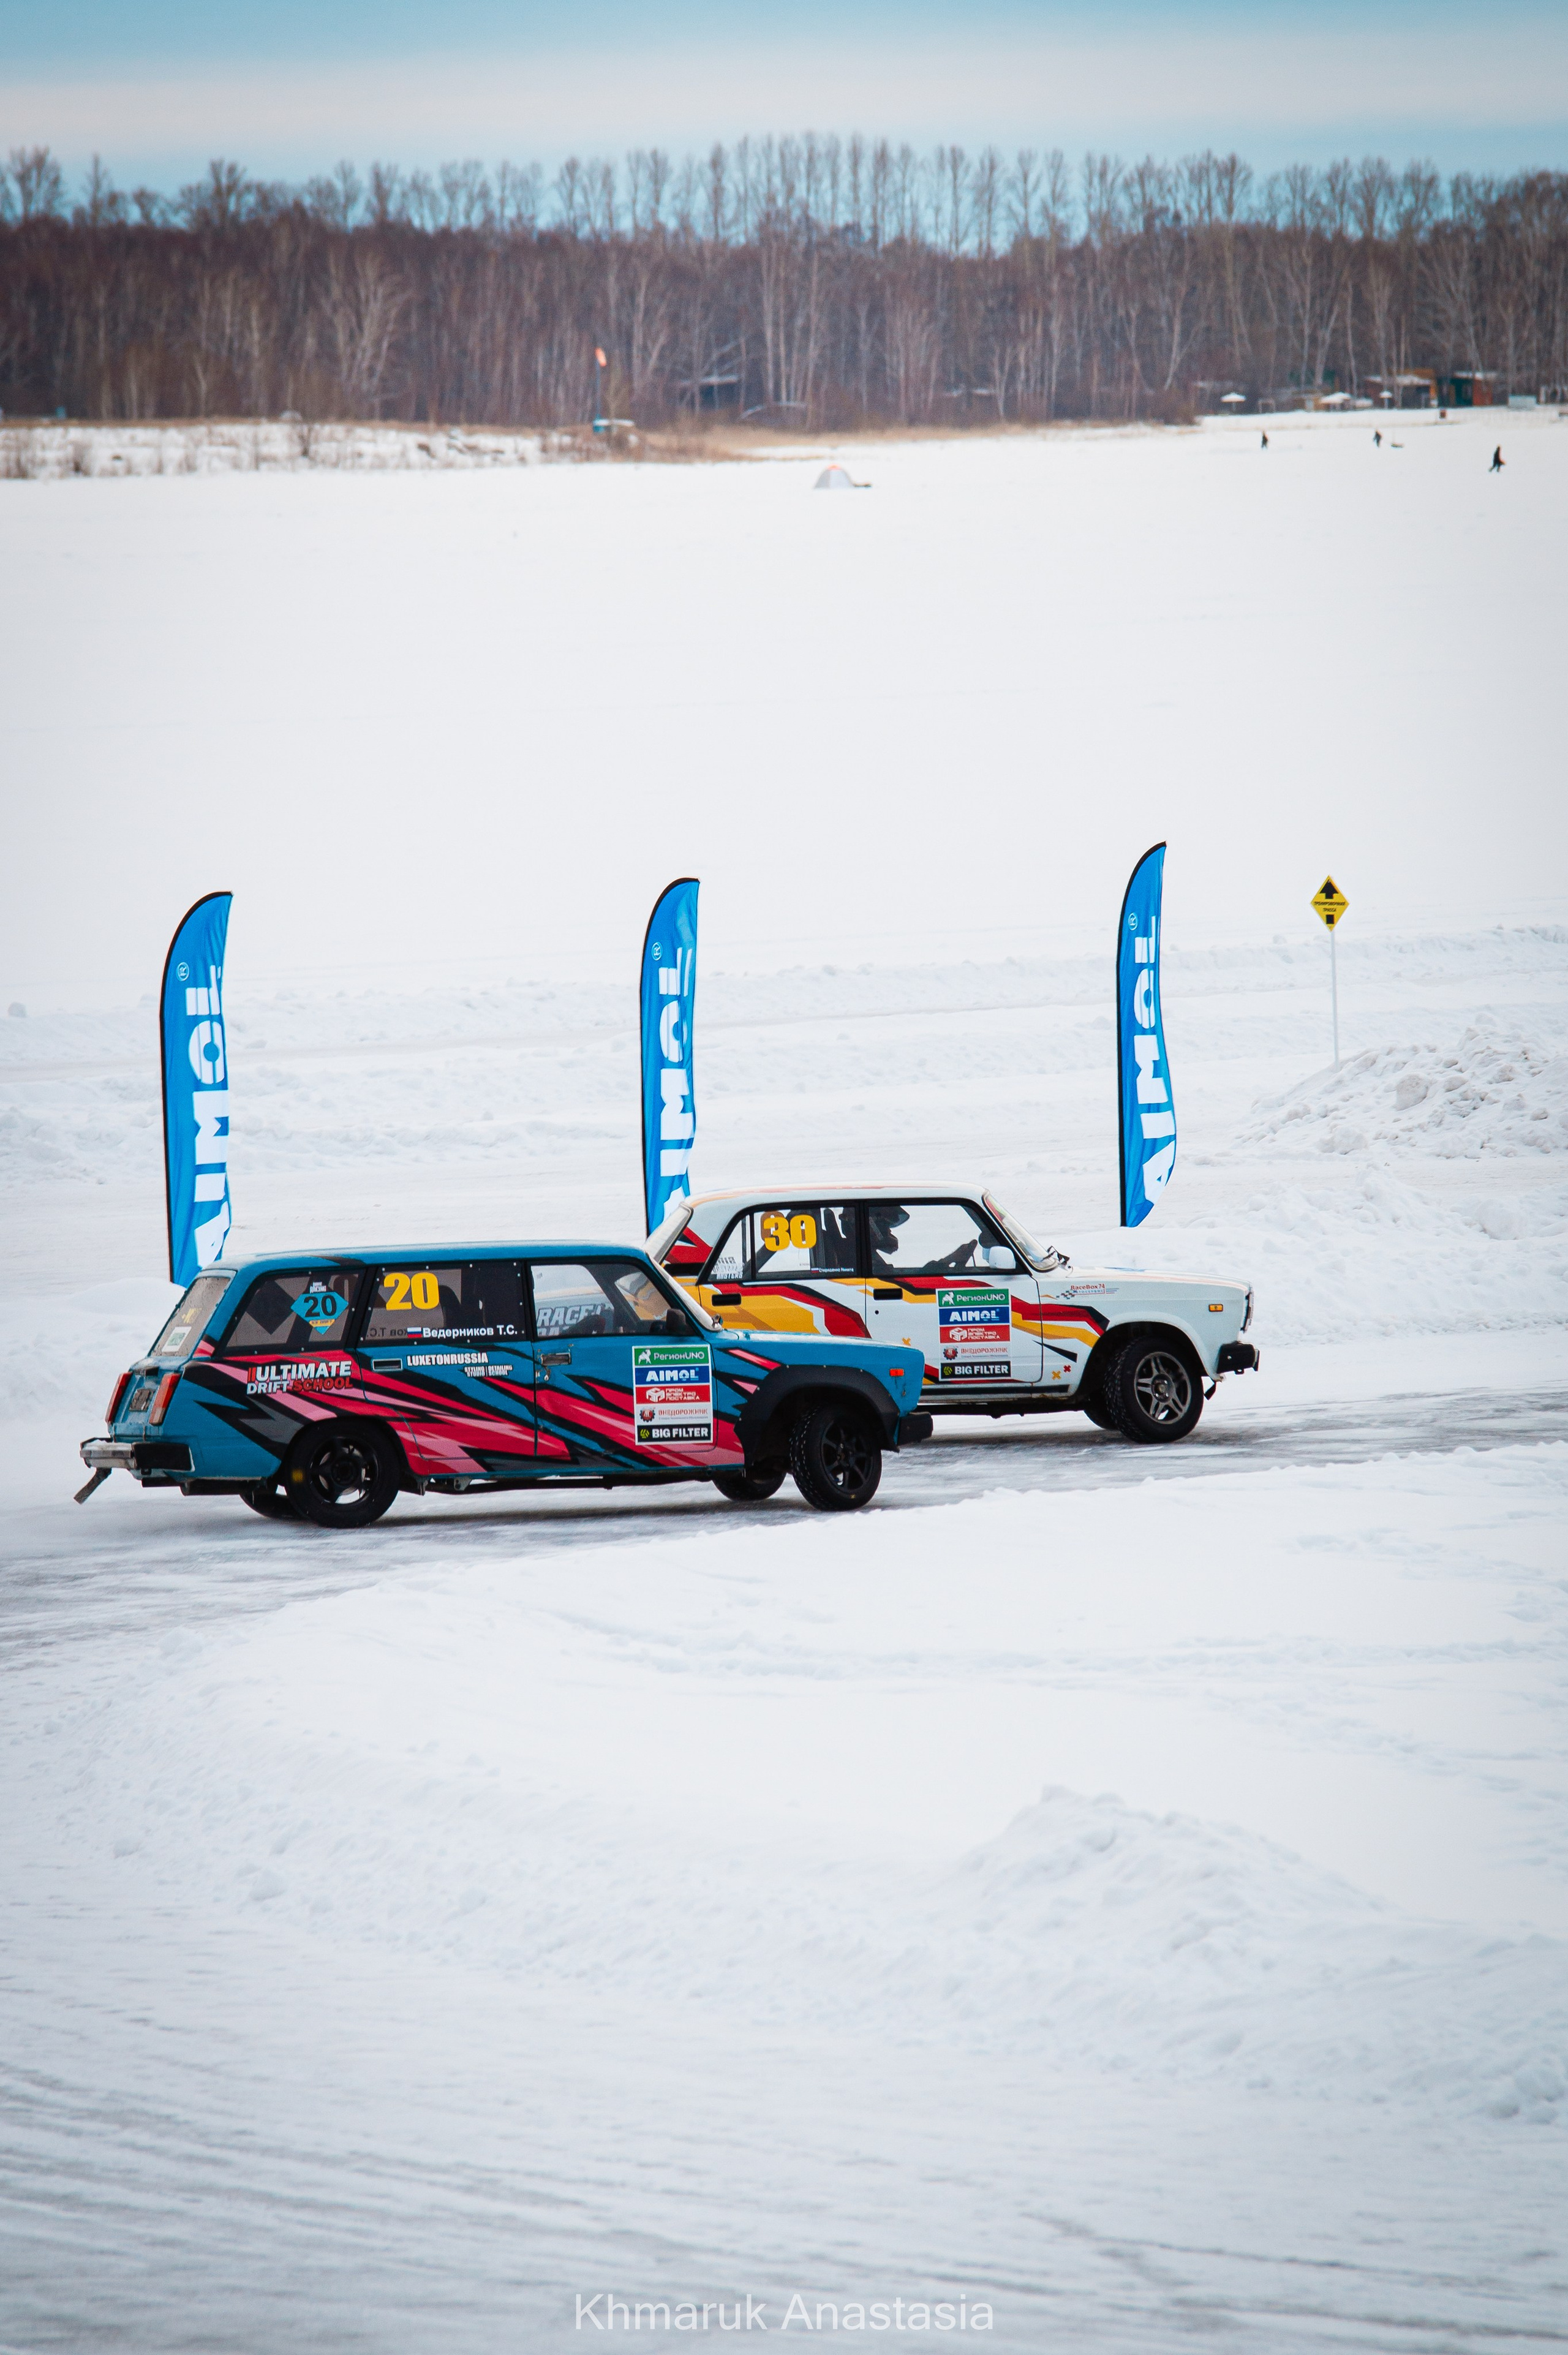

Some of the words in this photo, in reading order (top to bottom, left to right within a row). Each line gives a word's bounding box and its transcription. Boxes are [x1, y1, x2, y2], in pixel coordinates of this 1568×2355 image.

[1134, 916, 1176, 1205] AIMOL
[186, 965, 230, 1269] AIMOL
[763, 1215, 817, 1251] 30
[384, 1272, 440, 1310] 20
[303, 1295, 337, 1317] 20
[949, 1310, 1000, 1322] AIMOL
[423, 1327, 494, 1338] Ведерников
[497, 1325, 518, 1335] Т.С.
[407, 1352, 488, 1366] LUXETONRUSSIA
[654, 1351, 705, 1360] РегионUNO
[255, 1360, 352, 1382] ULTIMATE
[646, 1369, 699, 1382] AIMOL
[955, 1366, 973, 1374] BIG
[974, 1365, 1009, 1374] FILTER
[246, 1381, 289, 1395] DRIFT
[292, 1377, 353, 1392] SCHOOL
[652, 1428, 671, 1439] BIG
[673, 1427, 709, 1437] FILTER
